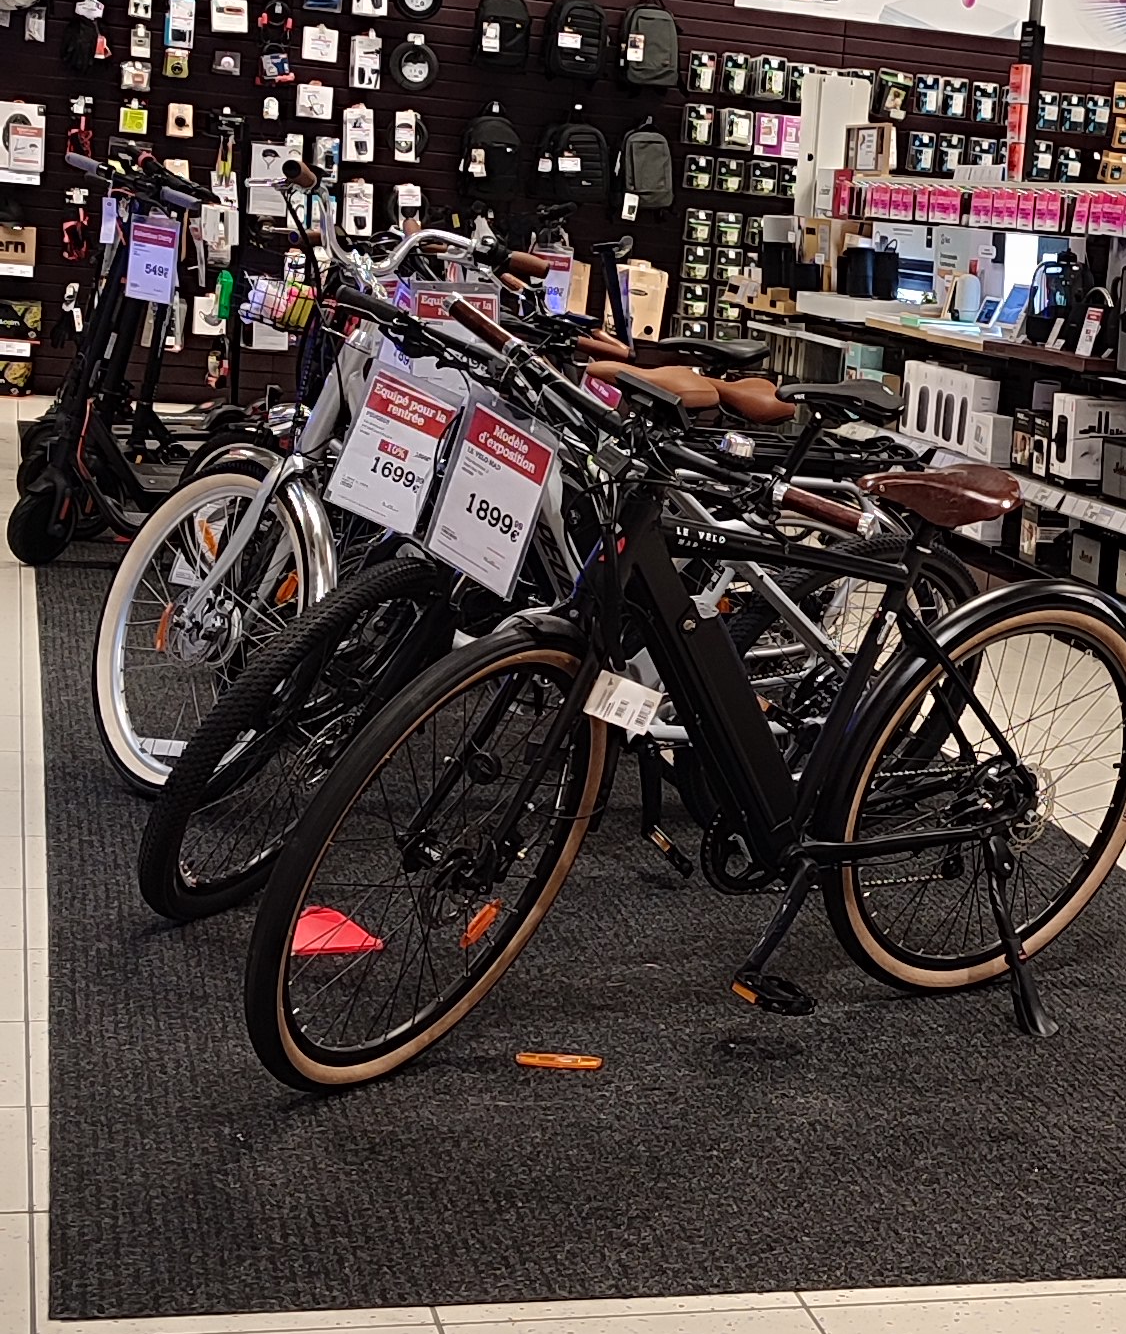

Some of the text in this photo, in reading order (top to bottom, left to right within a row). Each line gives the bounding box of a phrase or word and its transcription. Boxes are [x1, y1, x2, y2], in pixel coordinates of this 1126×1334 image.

[373, 382, 410, 406] Equipé
[409, 399, 437, 418] pour
[435, 409, 448, 424] la
[386, 403, 426, 427] rentrée
[478, 431, 536, 475] d'exposition
[493, 424, 530, 455] Modèle
[676, 526, 726, 544] LE VELO
